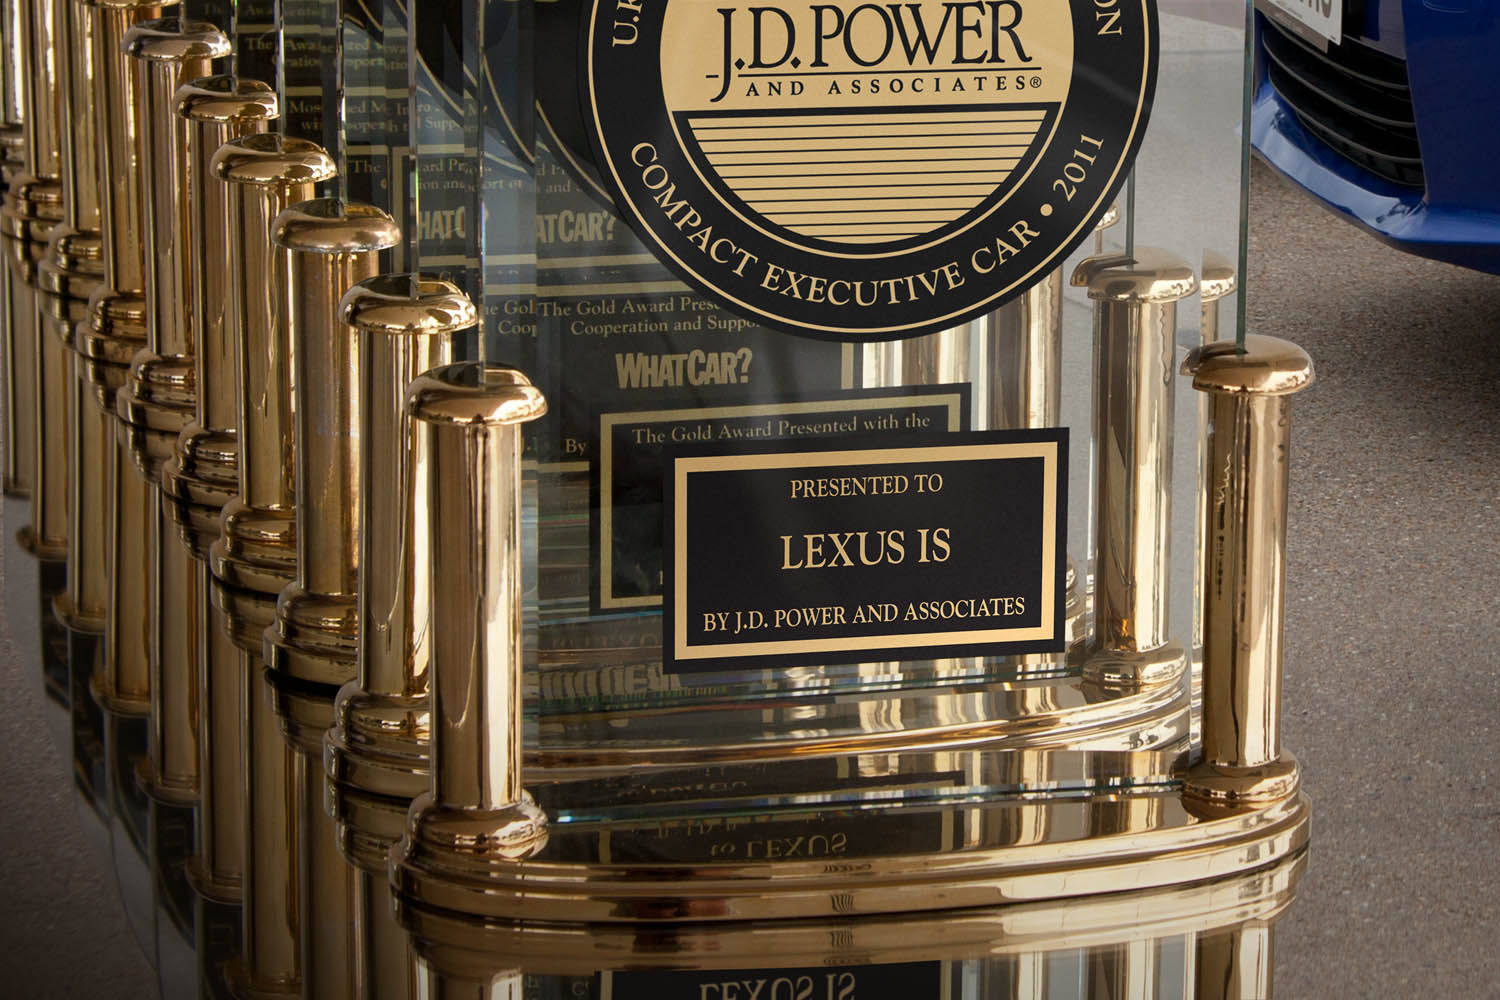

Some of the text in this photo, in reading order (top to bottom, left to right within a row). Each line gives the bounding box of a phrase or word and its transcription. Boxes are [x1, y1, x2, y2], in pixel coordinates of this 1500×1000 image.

[746, 80, 805, 97] AND
[631, 133, 1105, 307] COMPACT EXECUTIVE CAR 2011
[540, 302, 572, 318] The
[577, 299, 616, 316] Gold
[622, 296, 675, 314] Award
[570, 319, 668, 337] Cooperation
[673, 315, 702, 331] and
[632, 411, 932, 444] The Gold Award Presented with the
[565, 438, 587, 455] By
[790, 473, 943, 499] PRESENTED TO
[780, 527, 951, 570] LEXUS IS
[703, 596, 1025, 634] BY J.D. POWER AND ASSOCIATES
